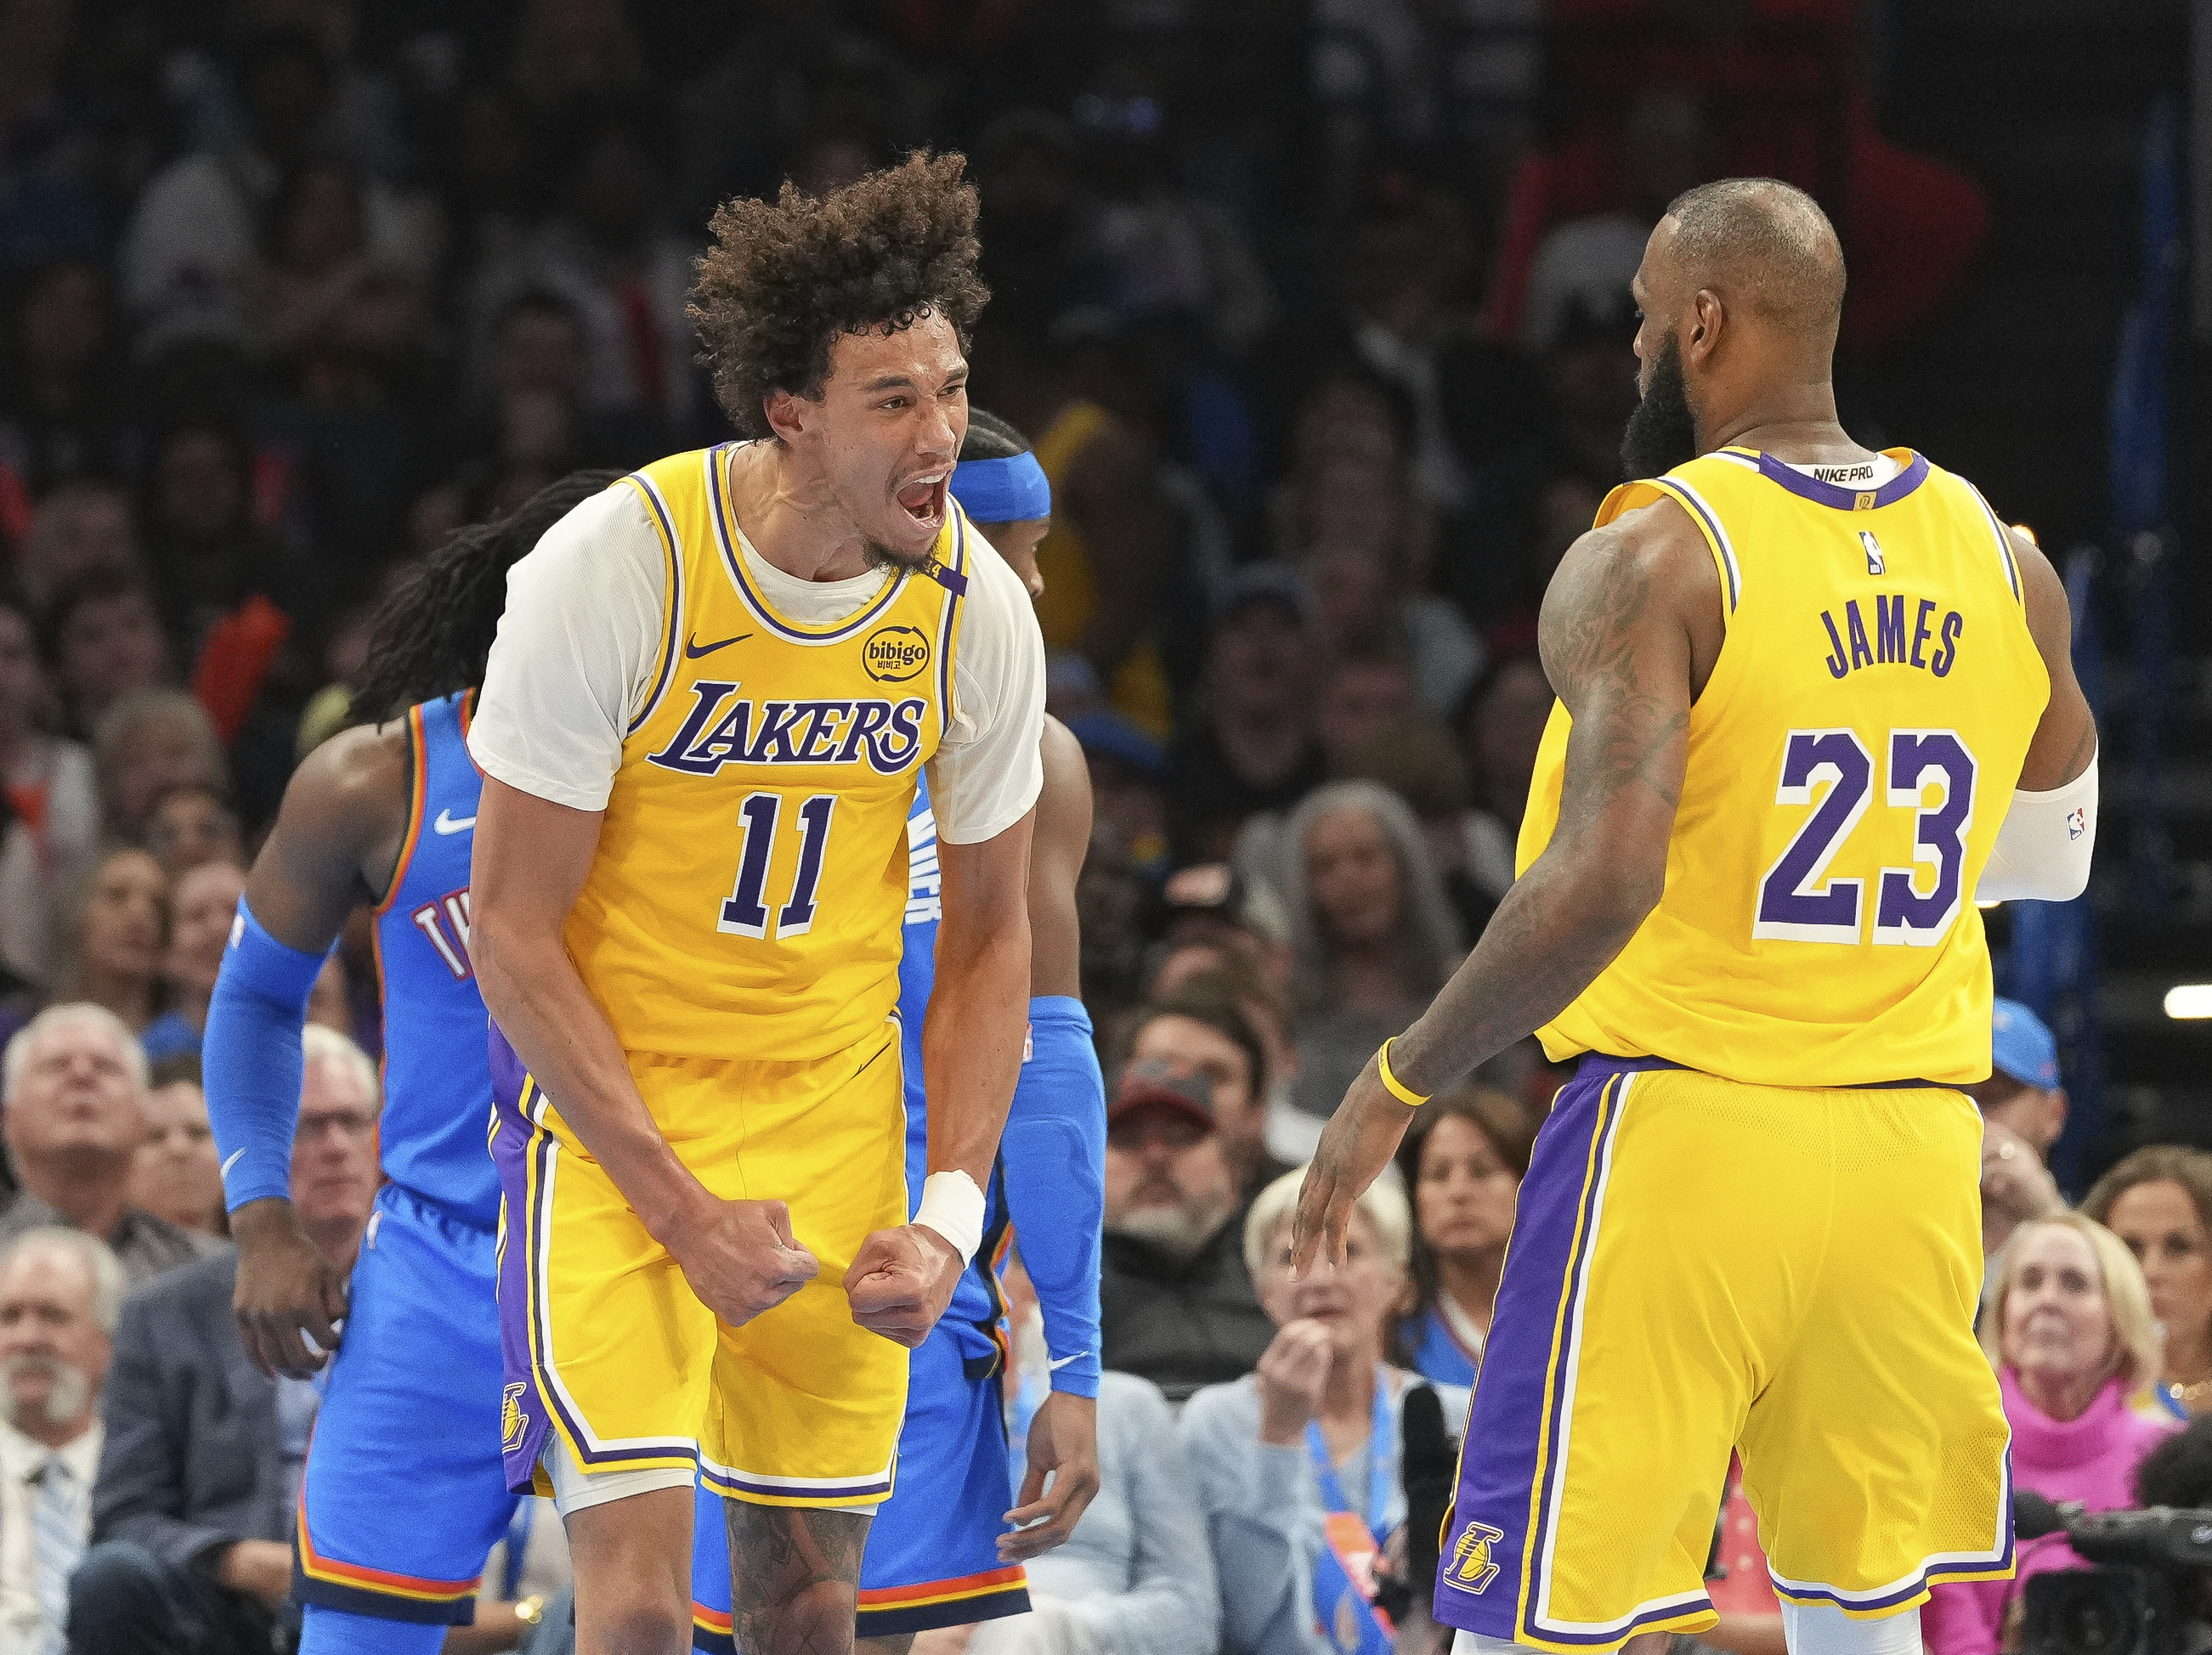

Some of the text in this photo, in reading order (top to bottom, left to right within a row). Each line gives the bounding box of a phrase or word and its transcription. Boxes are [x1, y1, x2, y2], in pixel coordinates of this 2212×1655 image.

[1813, 466, 1874, 483] NIKE PRO
[868, 641, 926, 666] bibigo
[877, 660, 902, 670] 비비고
[1820, 594, 1963, 679] JAMES
[643, 679, 929, 777] LAKERS
[716, 790, 840, 941] 11
[1751, 727, 1979, 946] 23
